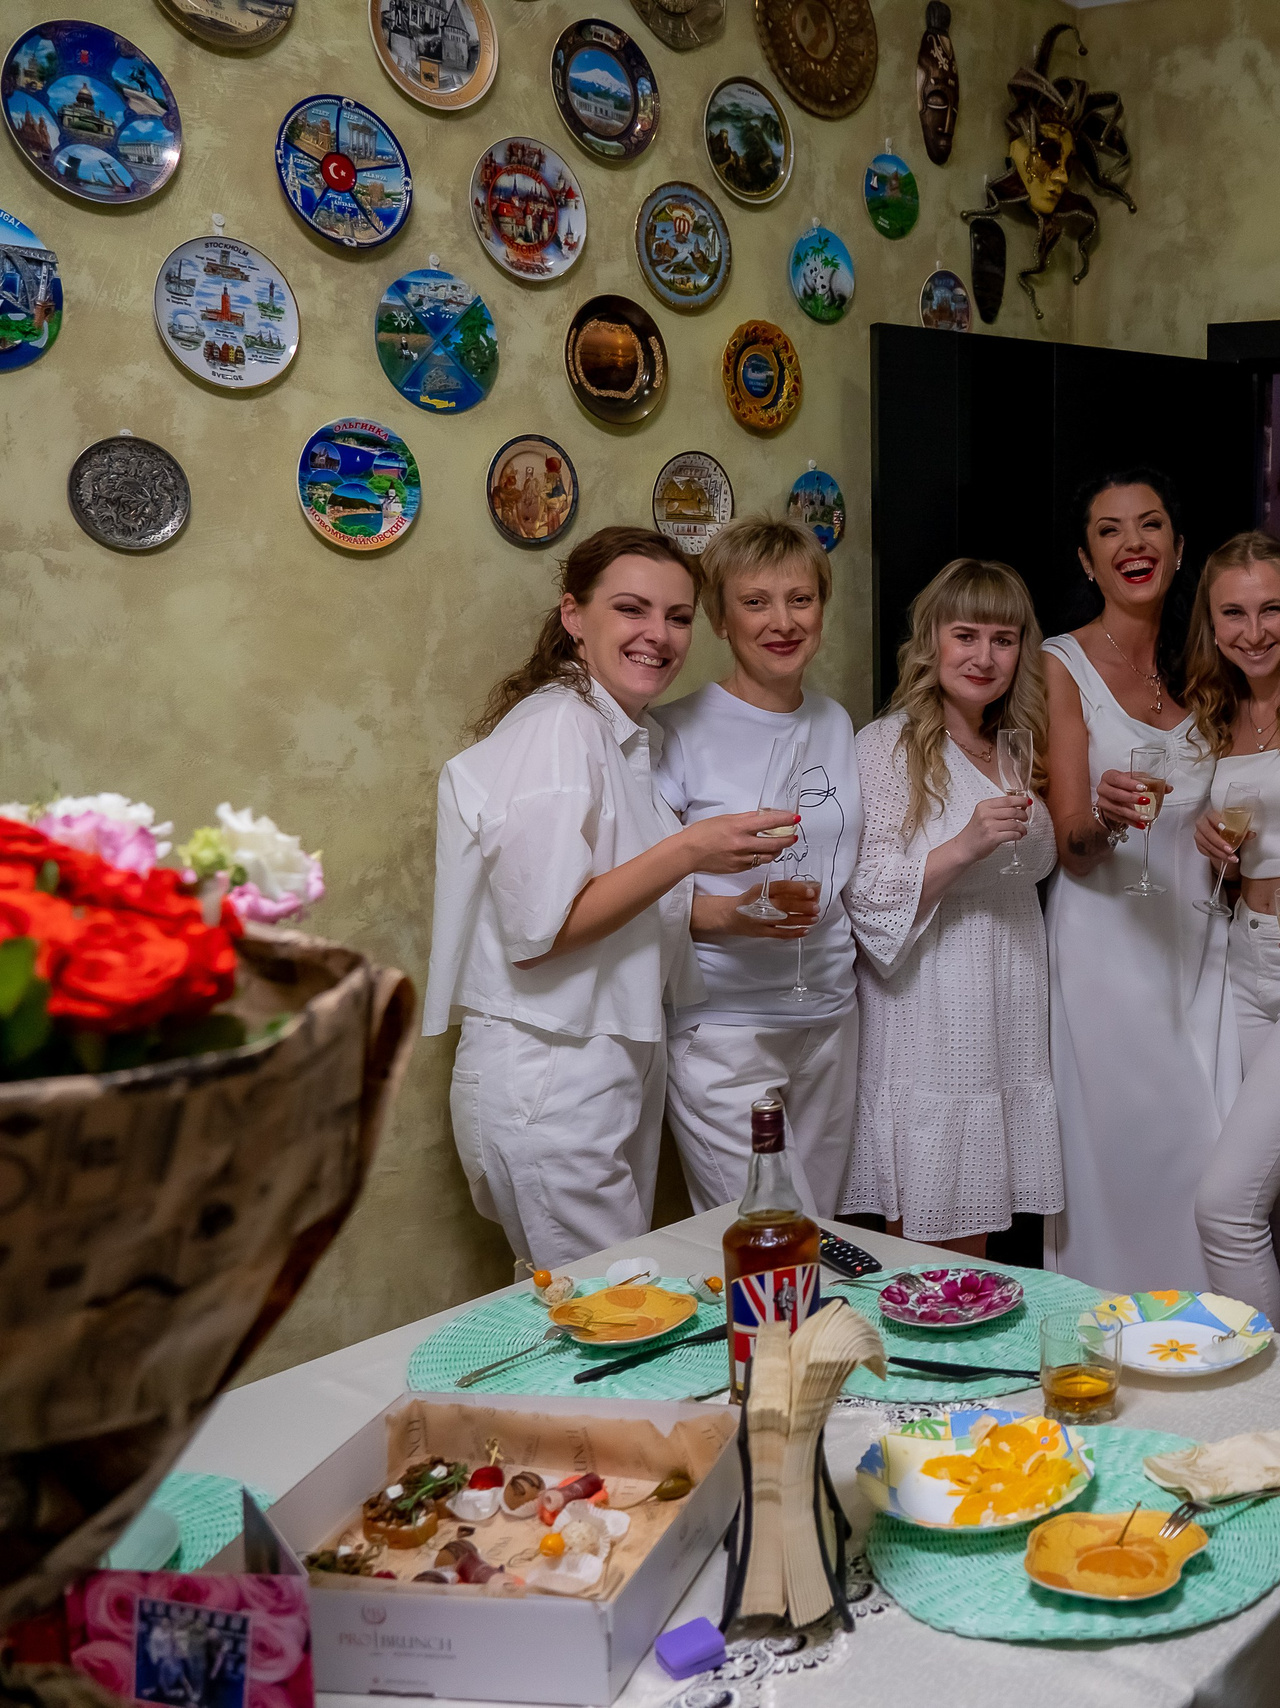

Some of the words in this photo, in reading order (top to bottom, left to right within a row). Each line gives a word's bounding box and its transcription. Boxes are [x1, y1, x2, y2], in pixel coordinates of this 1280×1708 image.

[204, 241, 250, 257] STOCKHOLM
[211, 370, 244, 381] SVEGE
[333, 421, 389, 440] ОЛЬГИНКА
[678, 467, 706, 477] EGYPT
[308, 505, 408, 545] НОВОМИХАЙЛОВСКИЙ
